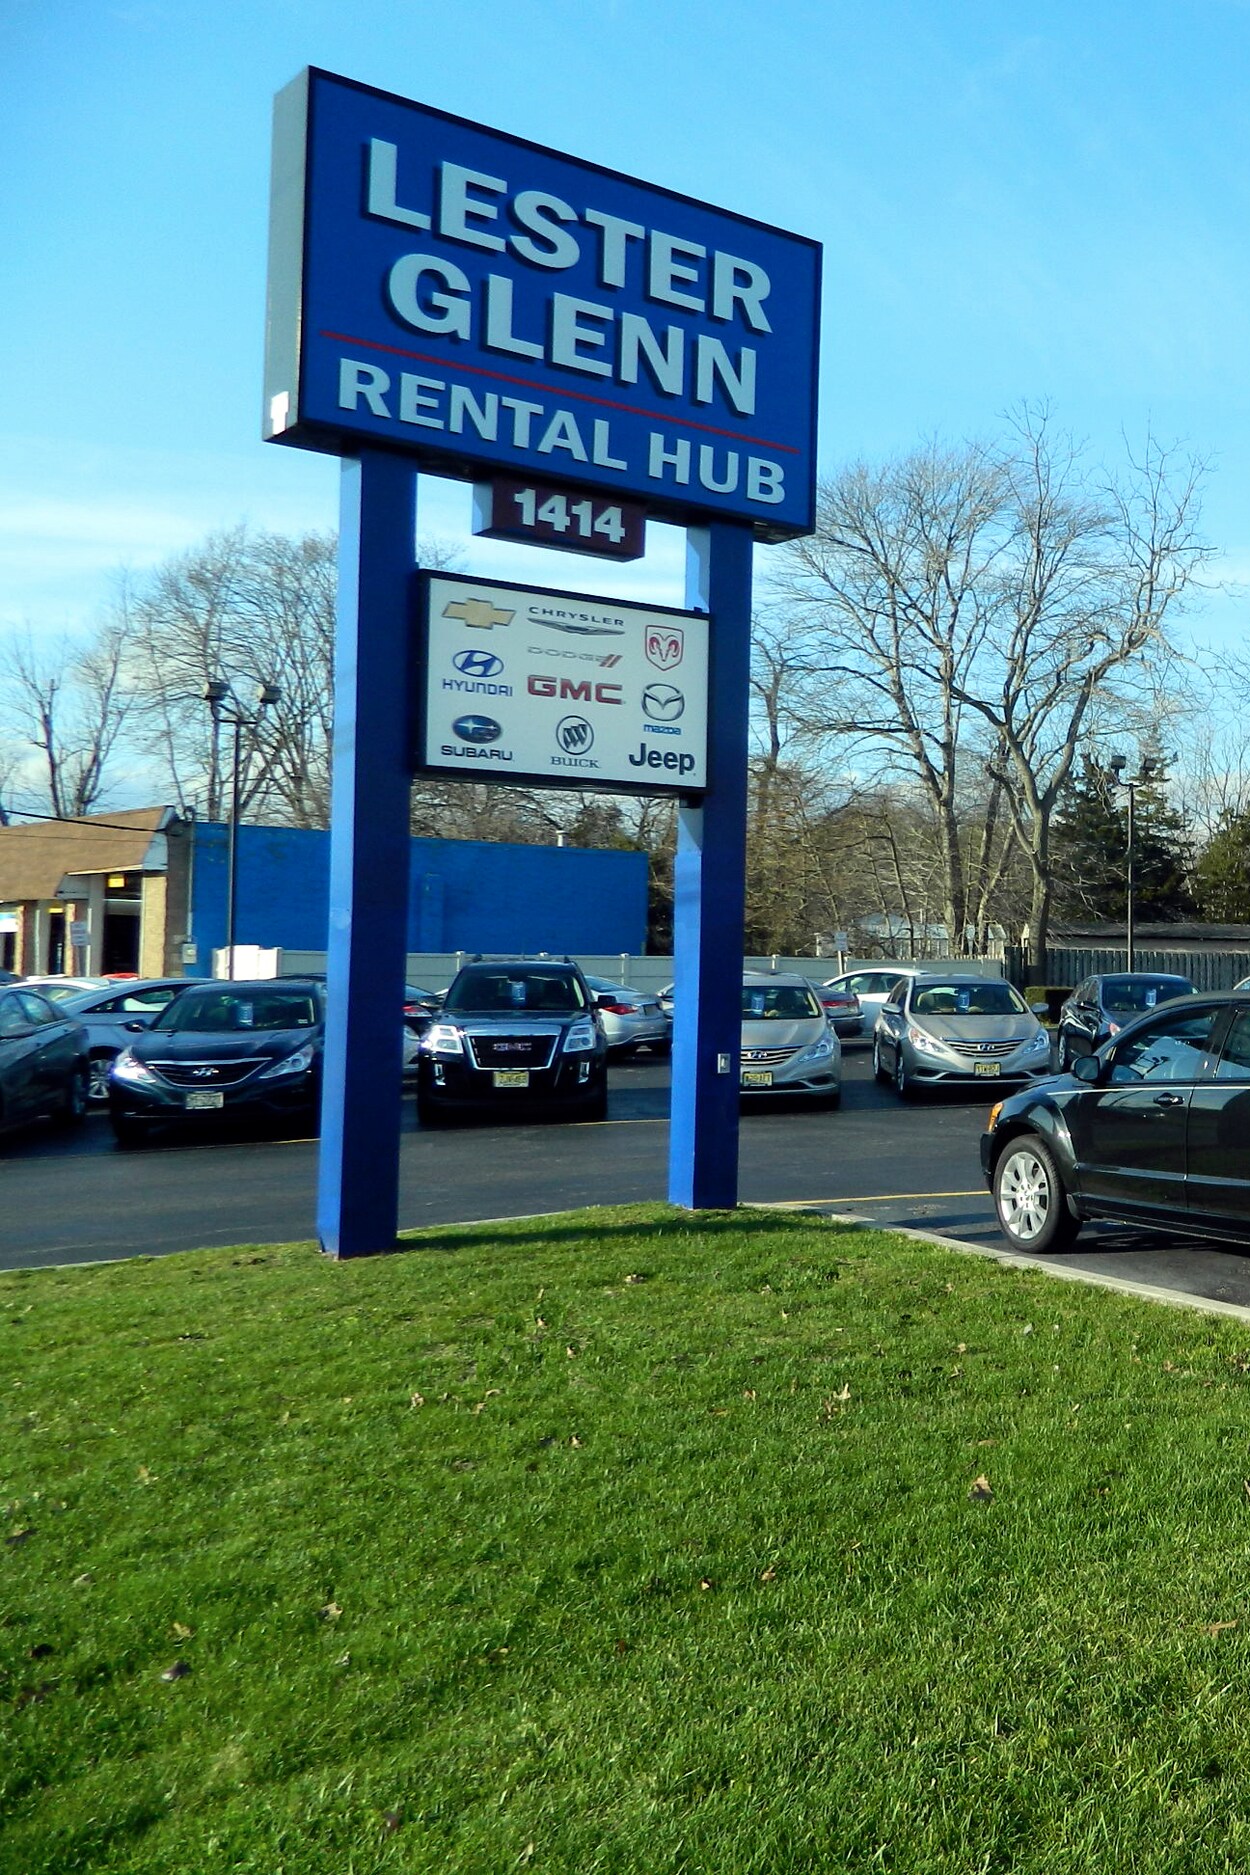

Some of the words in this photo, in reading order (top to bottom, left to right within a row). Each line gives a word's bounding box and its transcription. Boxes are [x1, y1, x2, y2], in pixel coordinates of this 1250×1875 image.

[367, 137, 773, 334] LESTER
[388, 253, 757, 416] GLENN
[338, 357, 628, 471] RENTAL
[648, 432, 786, 504] HUB
[514, 488, 626, 544] 1414
[528, 606, 625, 627] CHRYSLER
[442, 678, 513, 697] HYUNDAI
[527, 674, 623, 705] GMC
[643, 723, 682, 735] mazda
[440, 745, 513, 761] SUBARU
[551, 755, 600, 769] BUICK
[628, 742, 696, 775] Jeep
